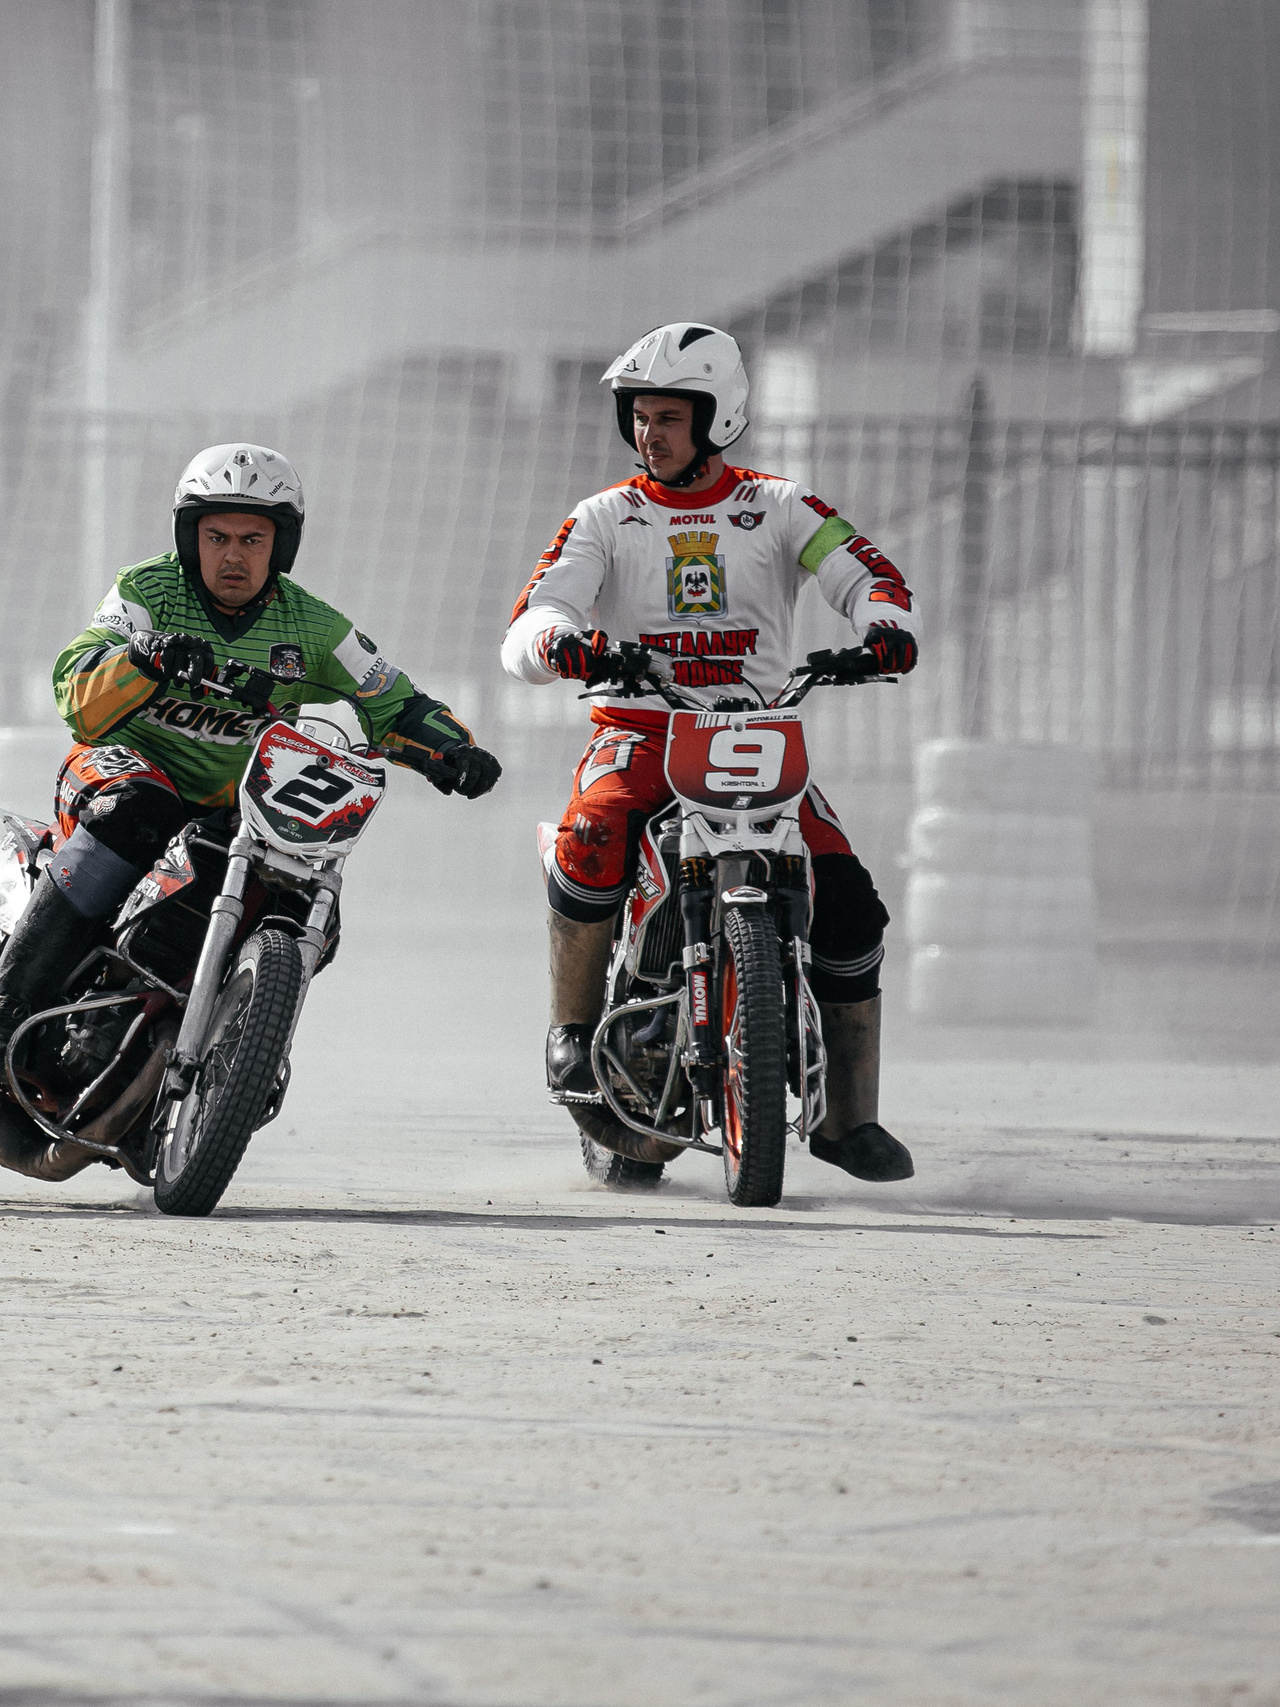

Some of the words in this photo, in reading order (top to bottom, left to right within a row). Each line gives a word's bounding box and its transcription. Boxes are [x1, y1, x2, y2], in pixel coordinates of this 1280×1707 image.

[269, 481, 284, 497] hebo
[669, 514, 716, 526] MOTUL
[671, 660, 744, 687] ИДНОЕ
[270, 733, 319, 753] GASGAS
[704, 728, 787, 792] 9
[271, 765, 355, 819] 2
[694, 974, 707, 1023] MOTUL
